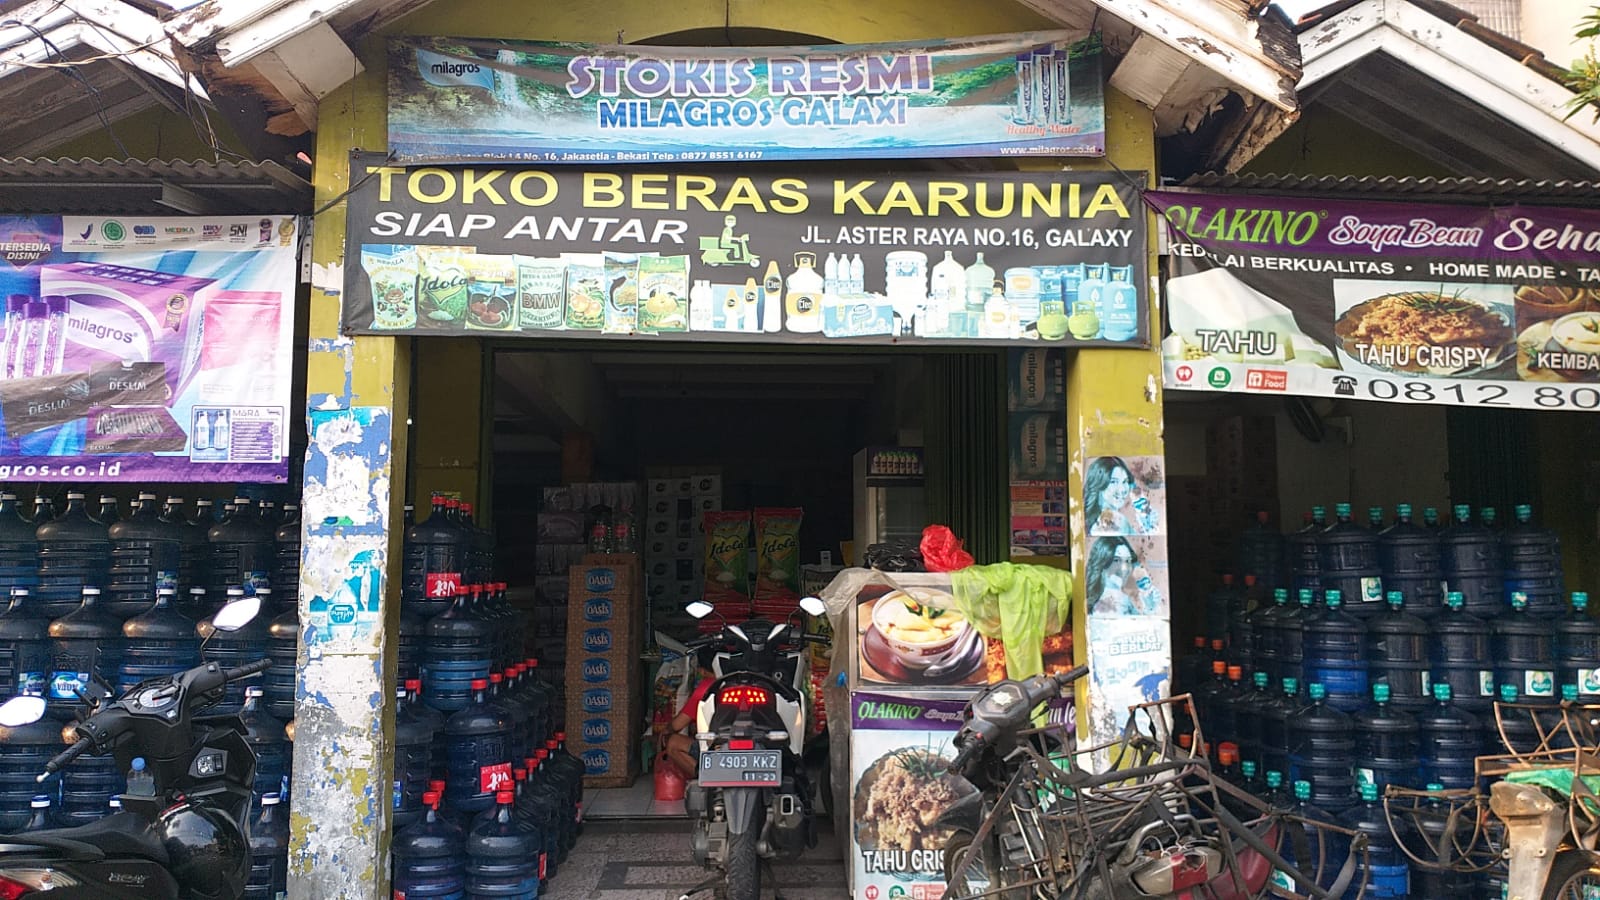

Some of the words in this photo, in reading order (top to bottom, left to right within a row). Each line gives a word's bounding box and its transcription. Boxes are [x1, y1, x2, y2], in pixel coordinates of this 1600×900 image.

[431, 60, 480, 77] milagros
[566, 54, 757, 98] STOKIS
[767, 53, 933, 96] RESMI
[598, 99, 774, 128] MILAGROS
[782, 97, 907, 128] GALAXI
[1007, 125, 1046, 136] Healthy
[523, 152, 541, 161] No.
[544, 152, 560, 162] 16,
[561, 152, 610, 161] Jakasetia
[616, 152, 650, 161] Bekasi
[651, 152, 674, 161] Telp
[681, 151, 707, 160] 0877
[709, 151, 734, 160] 8551
[737, 151, 763, 159] 6167
[366, 166, 559, 208] TOKO
[582, 172, 810, 215] BERAS
[833, 179, 1131, 220] KARUNIA
[370, 211, 496, 239] SIAP
[503, 215, 688, 245] ANTAR
[801, 225, 831, 245] JL.
[836, 226, 907, 246] ASTER
[913, 227, 969, 247] RAYA
[973, 228, 1039, 251] NO.16,
[1045, 229, 1133, 249] GALAXY
[1328, 216, 1402, 253] Soya
[1401, 218, 1484, 248] Bean
[0, 242, 51, 251] TERSEDIA
[7, 252, 40, 260] DISINI
[1251, 256, 1395, 276] BERKUALITAS
[1429, 262, 1490, 278] HOME
[1495, 265, 1556, 280] MADE
[421, 276, 468, 292] Idola
[521, 291, 561, 310] BMW
[67, 314, 133, 344] milagros
[1197, 329, 1276, 357] TAHU
[1355, 343, 1409, 367] TAHU
[1416, 345, 1490, 370] CRISPY
[1538, 352, 1600, 371] KEMBA
[109, 380, 147, 391] DESLIM
[1027, 353, 1038, 398] milagros
[1264, 379, 1285, 389] Food
[1368, 378, 1511, 406] 0812
[1534, 385, 1600, 410] 80
[29, 399, 71, 416] DESLIM
[1027, 423, 1038, 467] milagros
[0, 461, 121, 481] gros.co.id
[710, 541, 744, 557] Idola
[761, 538, 797, 556] Idola
[704, 756, 711, 769] B
[719, 756, 748, 768] 4903
[752, 756, 777, 768] KKZ
[863, 850, 906, 872] TAHU
